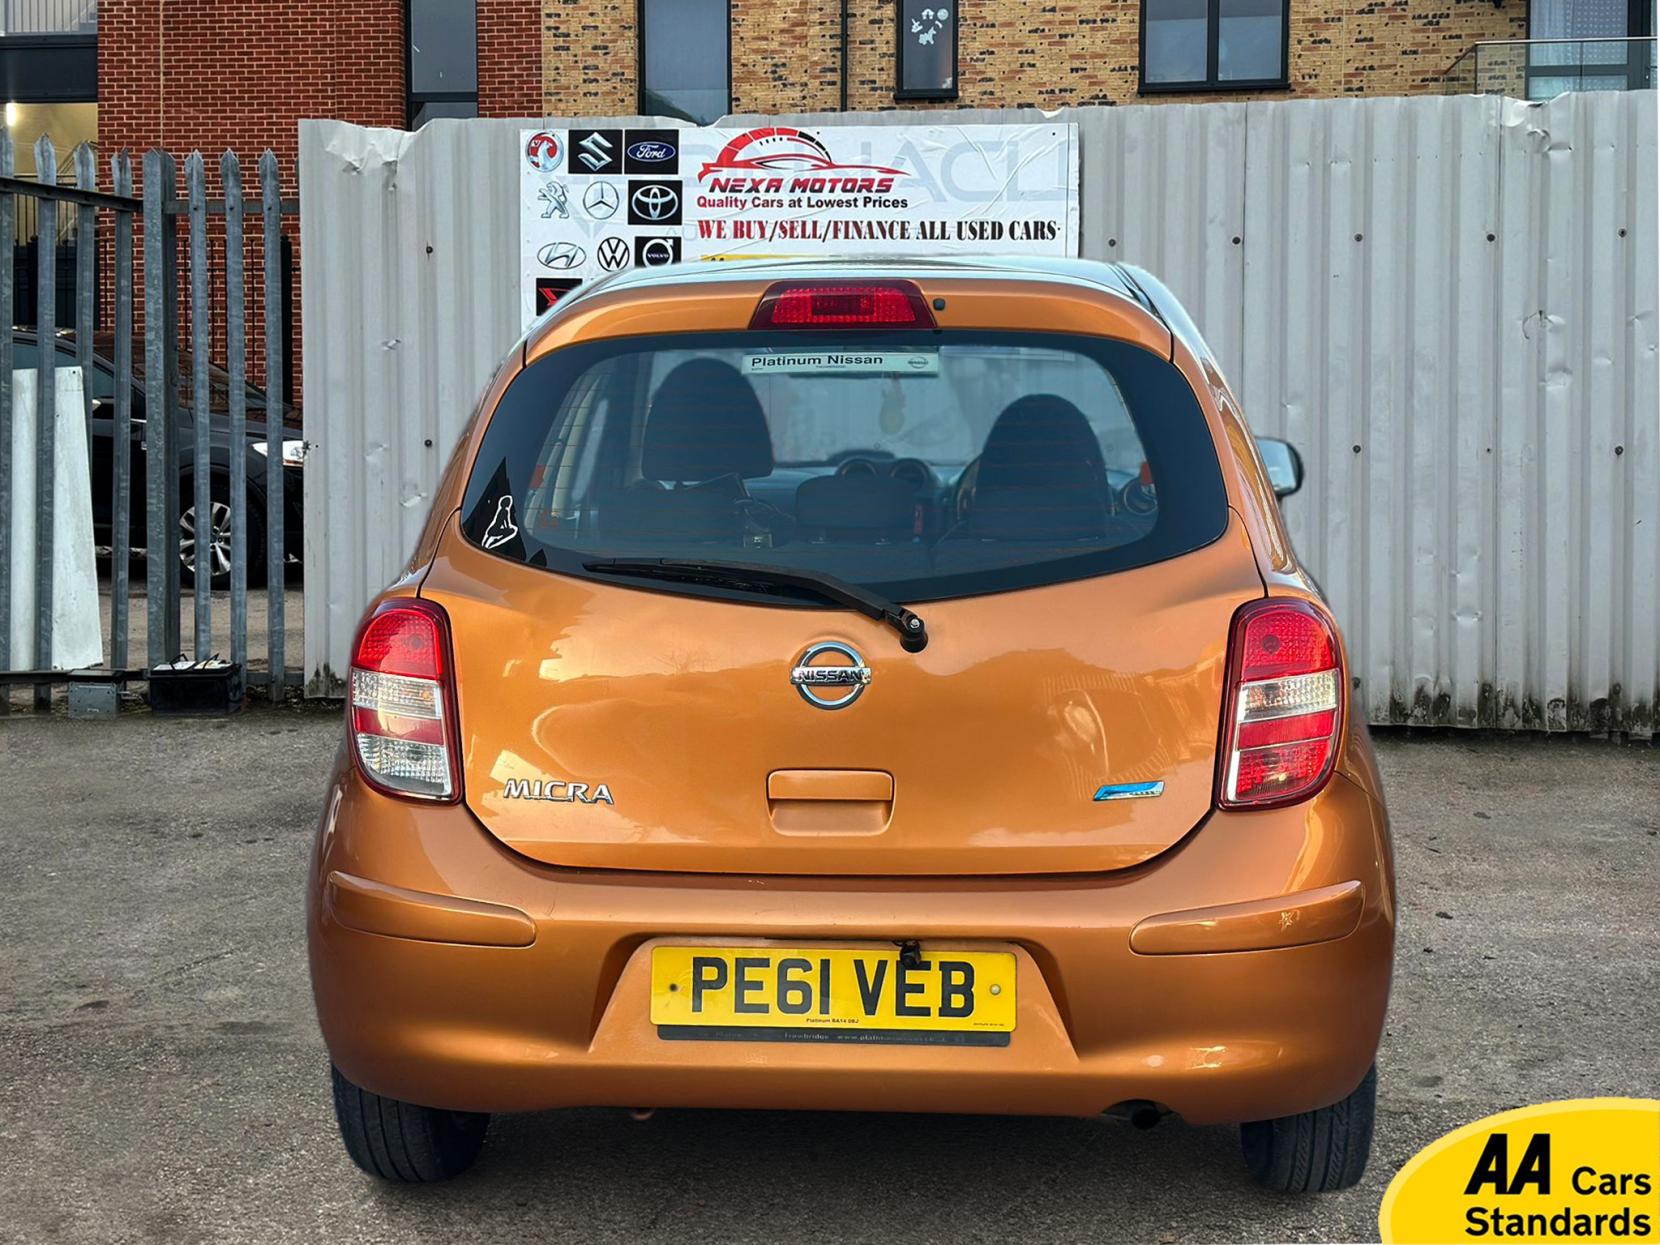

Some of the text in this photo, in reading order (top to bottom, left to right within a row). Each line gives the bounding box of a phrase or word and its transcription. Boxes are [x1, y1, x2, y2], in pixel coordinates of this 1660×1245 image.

[636, 144, 666, 159] Ford
[709, 178, 894, 194] NEXA MOTORS
[697, 196, 908, 211] Quality Cars at Lowest Prices
[697, 220, 727, 240] WE
[733, 220, 910, 243] BUY/SELL/FINANCE
[916, 220, 951, 240] ALL
[956, 220, 1004, 241] USED
[751, 356, 822, 367] Platinum
[827, 354, 884, 366] Nissan
[799, 669, 865, 682] NISSAN
[503, 778, 614, 805] MICRA
[691, 956, 975, 1018] PE61 VEB
